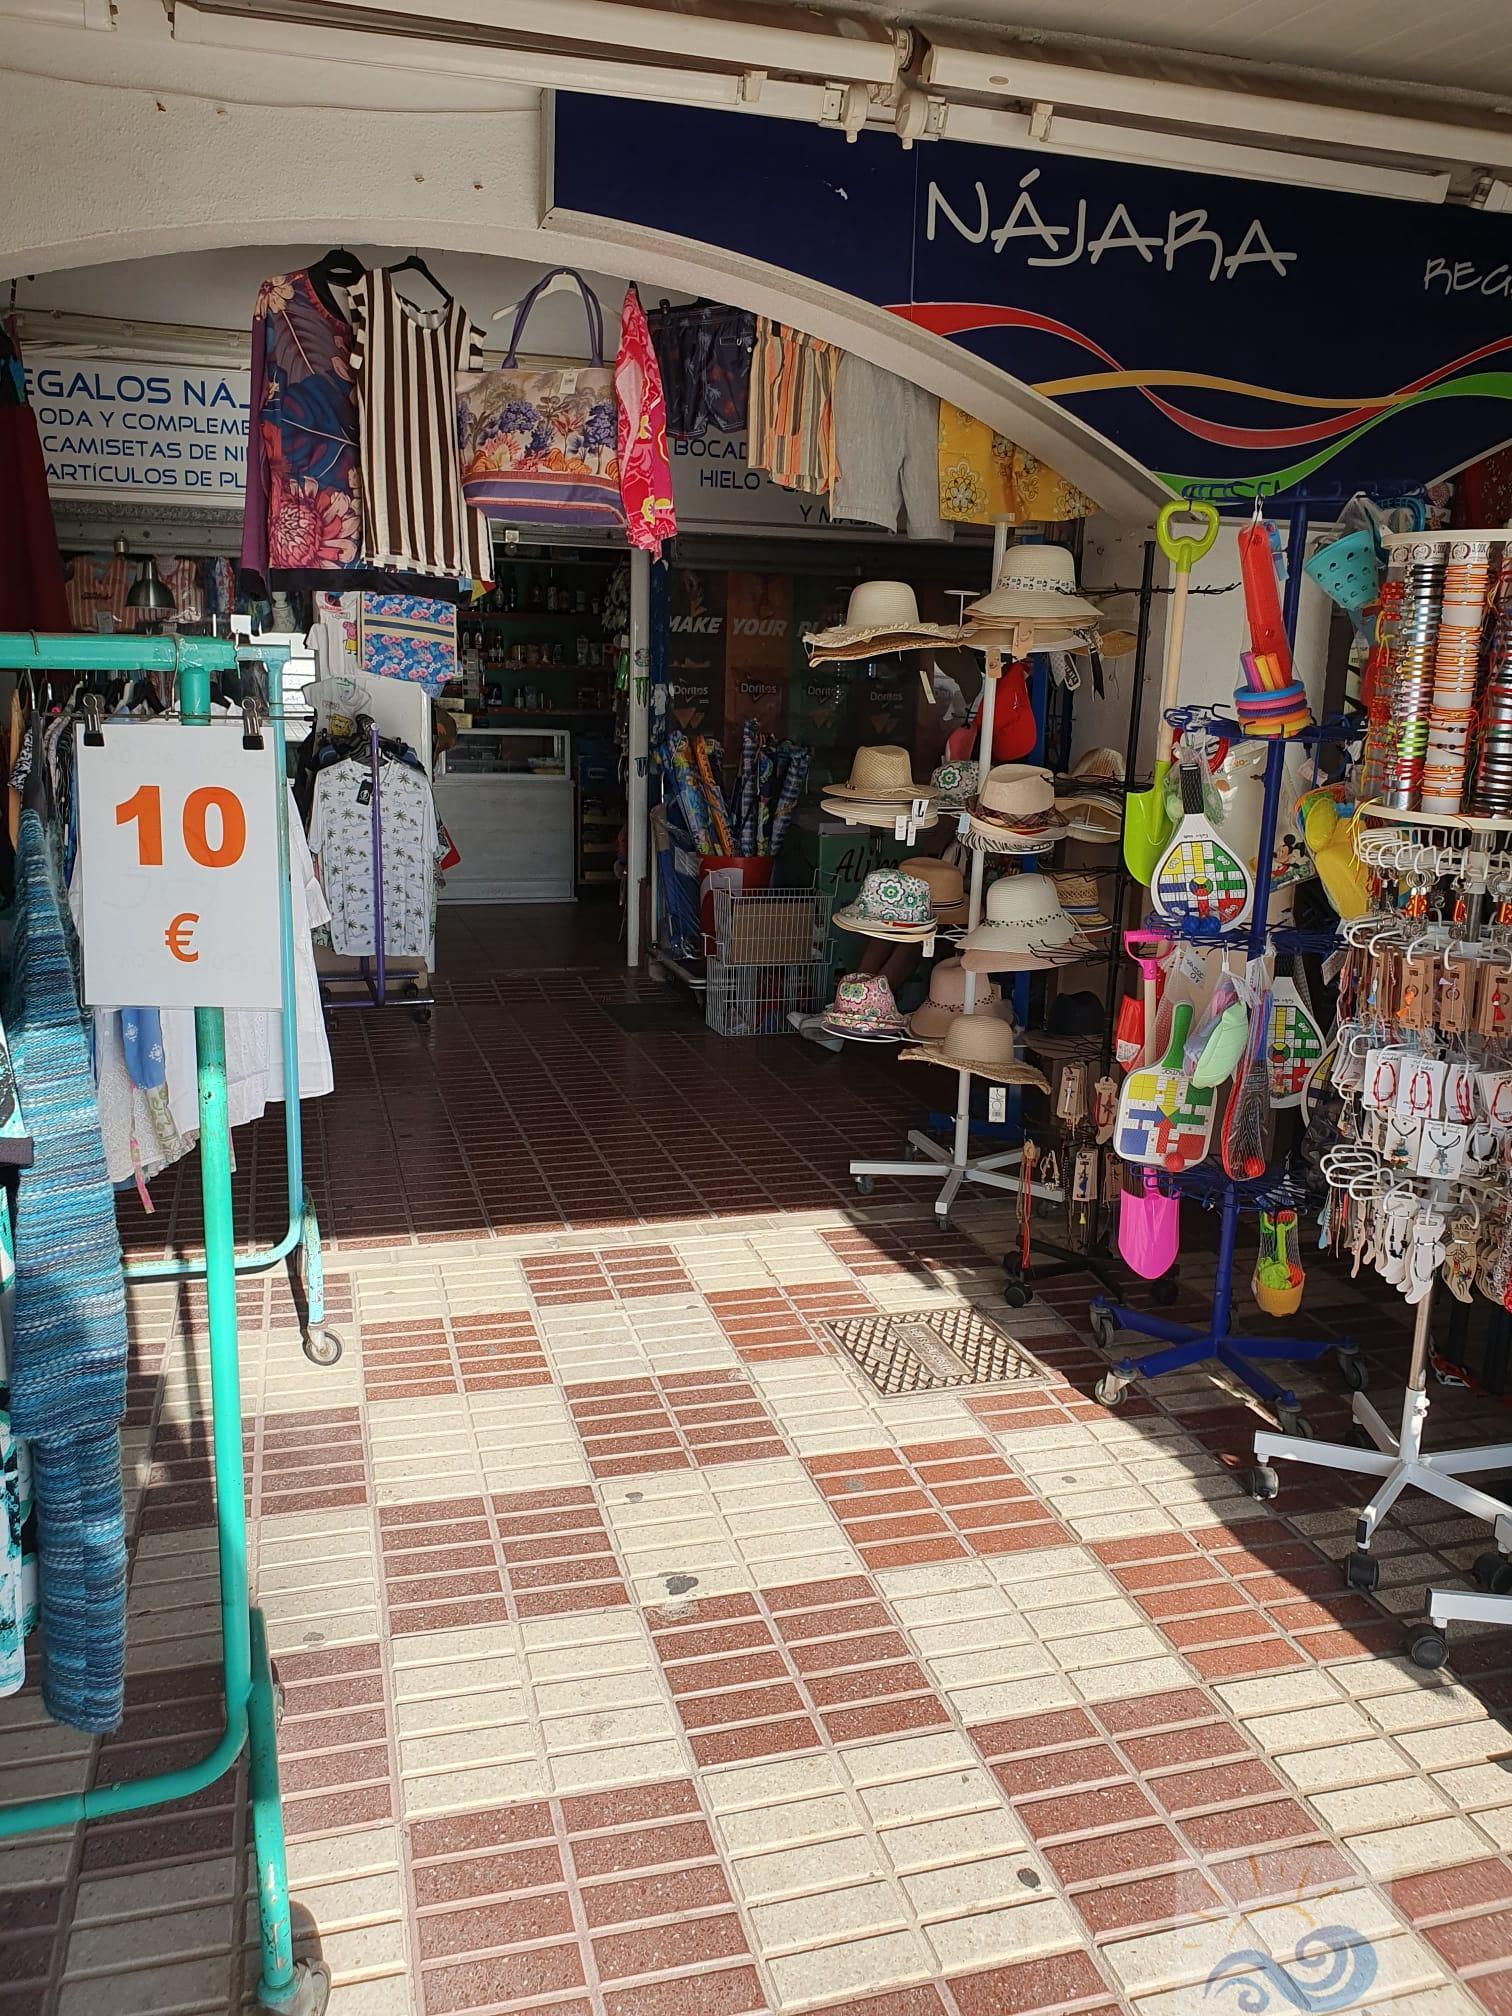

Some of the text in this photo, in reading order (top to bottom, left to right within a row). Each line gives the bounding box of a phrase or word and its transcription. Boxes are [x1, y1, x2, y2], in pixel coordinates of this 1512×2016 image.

[926, 168, 1298, 281] NÁJARA
[1423, 257, 1512, 297] REG
[183, 378, 250, 409] NÁ
[99, 410, 115, 428] Y
[43, 435, 182, 459] CAMISETAS
[189, 443, 217, 461] DE
[45, 462, 177, 485] ARTÍCULOS
[184, 469, 212, 487] DE
[700, 468, 761, 491] HIELO
[799, 504, 812, 523] Y
[669, 615, 723, 635] MAKE
[732, 617, 788, 638] YOUR
[673, 684, 709, 697] Doritos
[740, 682, 777, 697] Doritos
[869, 690, 904, 703] Doritos
[115, 785, 247, 868] 10
[164, 912, 200, 963] €
